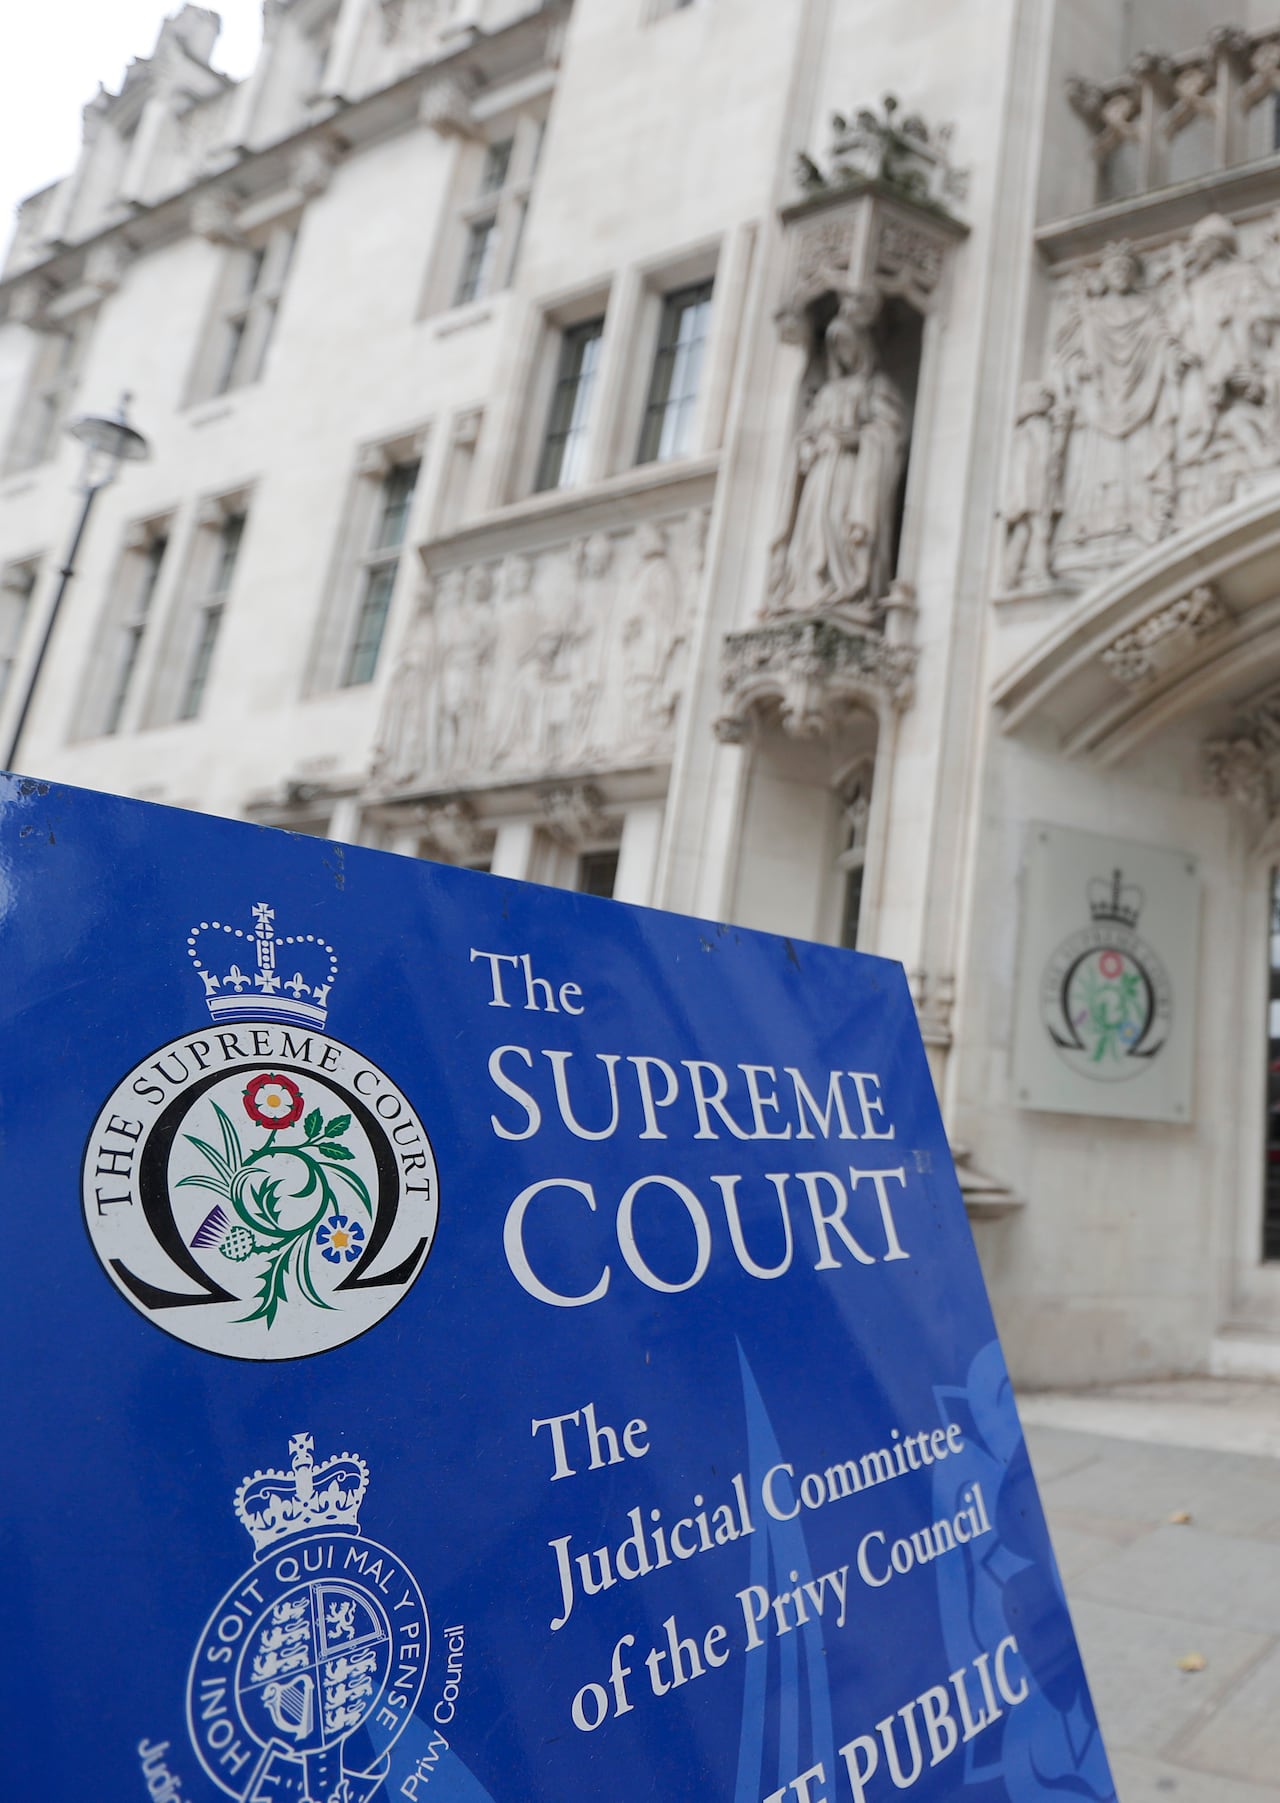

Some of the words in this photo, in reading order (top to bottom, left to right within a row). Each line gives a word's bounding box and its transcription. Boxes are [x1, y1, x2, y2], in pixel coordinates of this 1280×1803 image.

[469, 948, 585, 1016] The
[94, 1114, 145, 1216] THE
[132, 1029, 343, 1106] SUPREME
[352, 1070, 432, 1202] COURT
[487, 1045, 896, 1142] SUPREME
[503, 1166, 911, 1308] COURT
[531, 1402, 651, 1482] The
[275, 1544, 333, 1582] QUI
[342, 1545, 396, 1595] MAL
[549, 1472, 757, 1632] Judicial
[760, 1421, 966, 1522] Committee
[206, 1578, 264, 1664] SOIT
[392, 1589, 416, 1612] Y
[570, 1634, 636, 1733] of
[645, 1615, 731, 1697] the
[735, 1564, 850, 1653] Privy
[855, 1481, 993, 1589] Council
[200, 1676, 251, 1776] HONI
[375, 1621, 420, 1731] PENSE
[400, 1729, 450, 1803] Privy
[433, 1624, 465, 1724] Council
[837, 1635, 1030, 1803] PUBLIC
